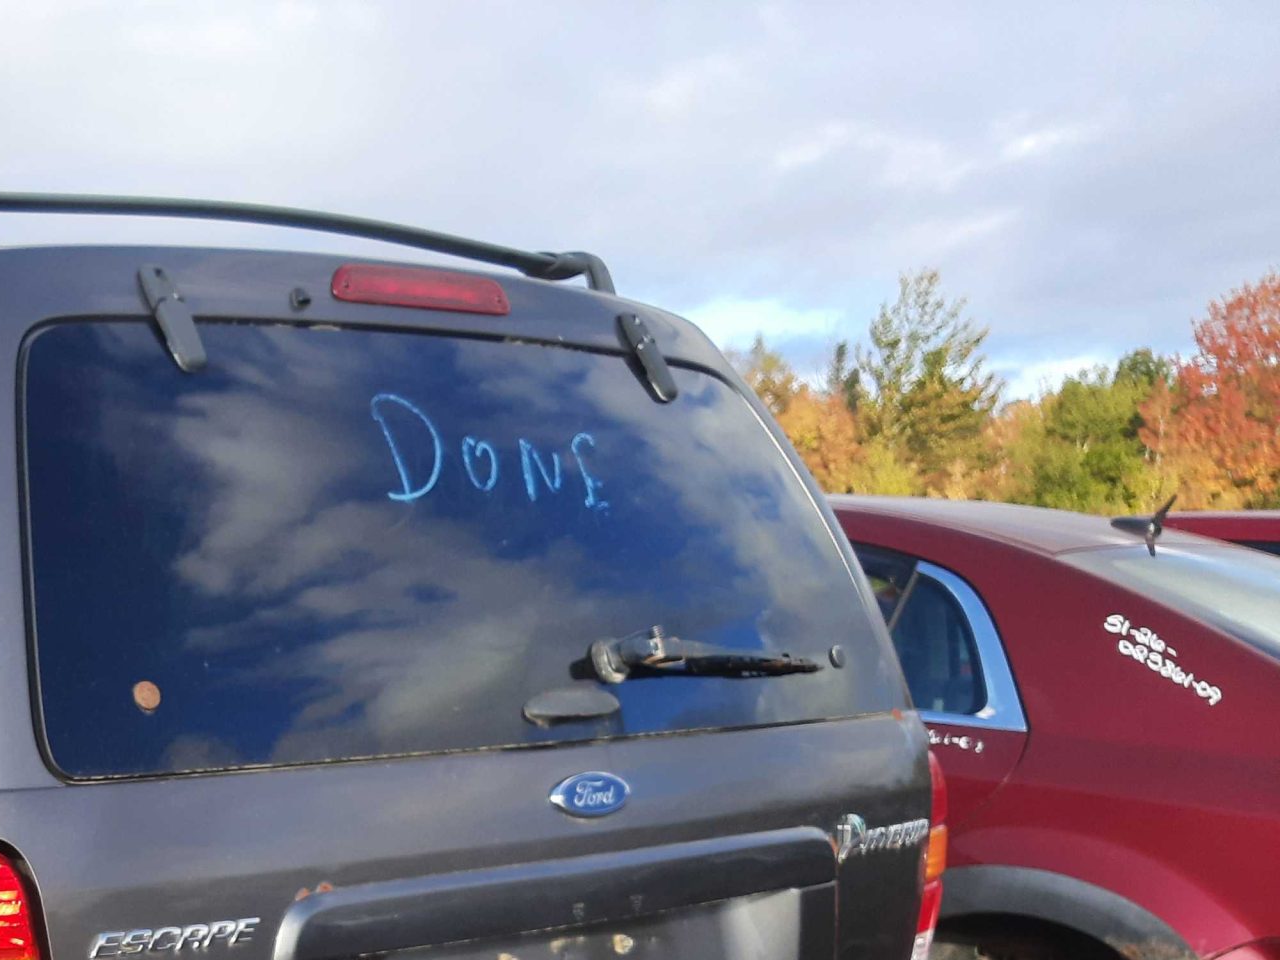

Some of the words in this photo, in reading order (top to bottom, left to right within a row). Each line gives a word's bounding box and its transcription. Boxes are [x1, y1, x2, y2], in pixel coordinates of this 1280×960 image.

[371, 393, 609, 514] DONE
[574, 780, 614, 807] Ford
[89, 917, 261, 960] ESCAPE
